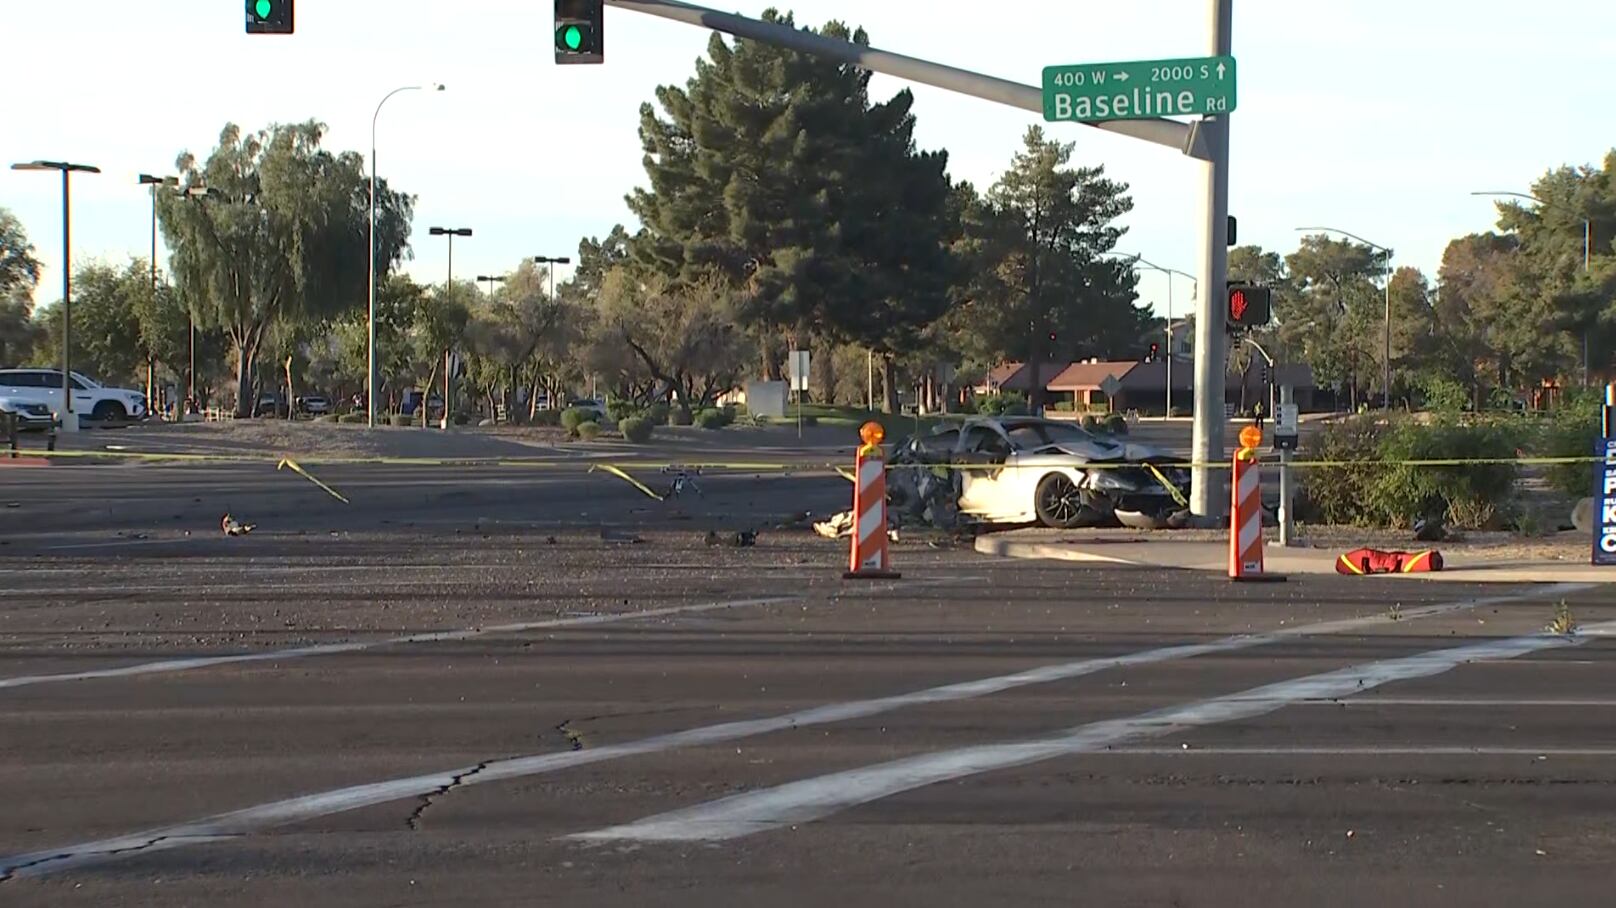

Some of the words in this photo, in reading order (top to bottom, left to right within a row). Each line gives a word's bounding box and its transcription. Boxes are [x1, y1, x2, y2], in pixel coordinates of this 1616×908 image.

[1054, 72, 1085, 86] 400
[1091, 71, 1106, 84] W
[1151, 66, 1193, 81] 2000
[1200, 65, 1209, 79] S
[1054, 87, 1194, 119] Baseline
[1206, 96, 1226, 112] Rd
